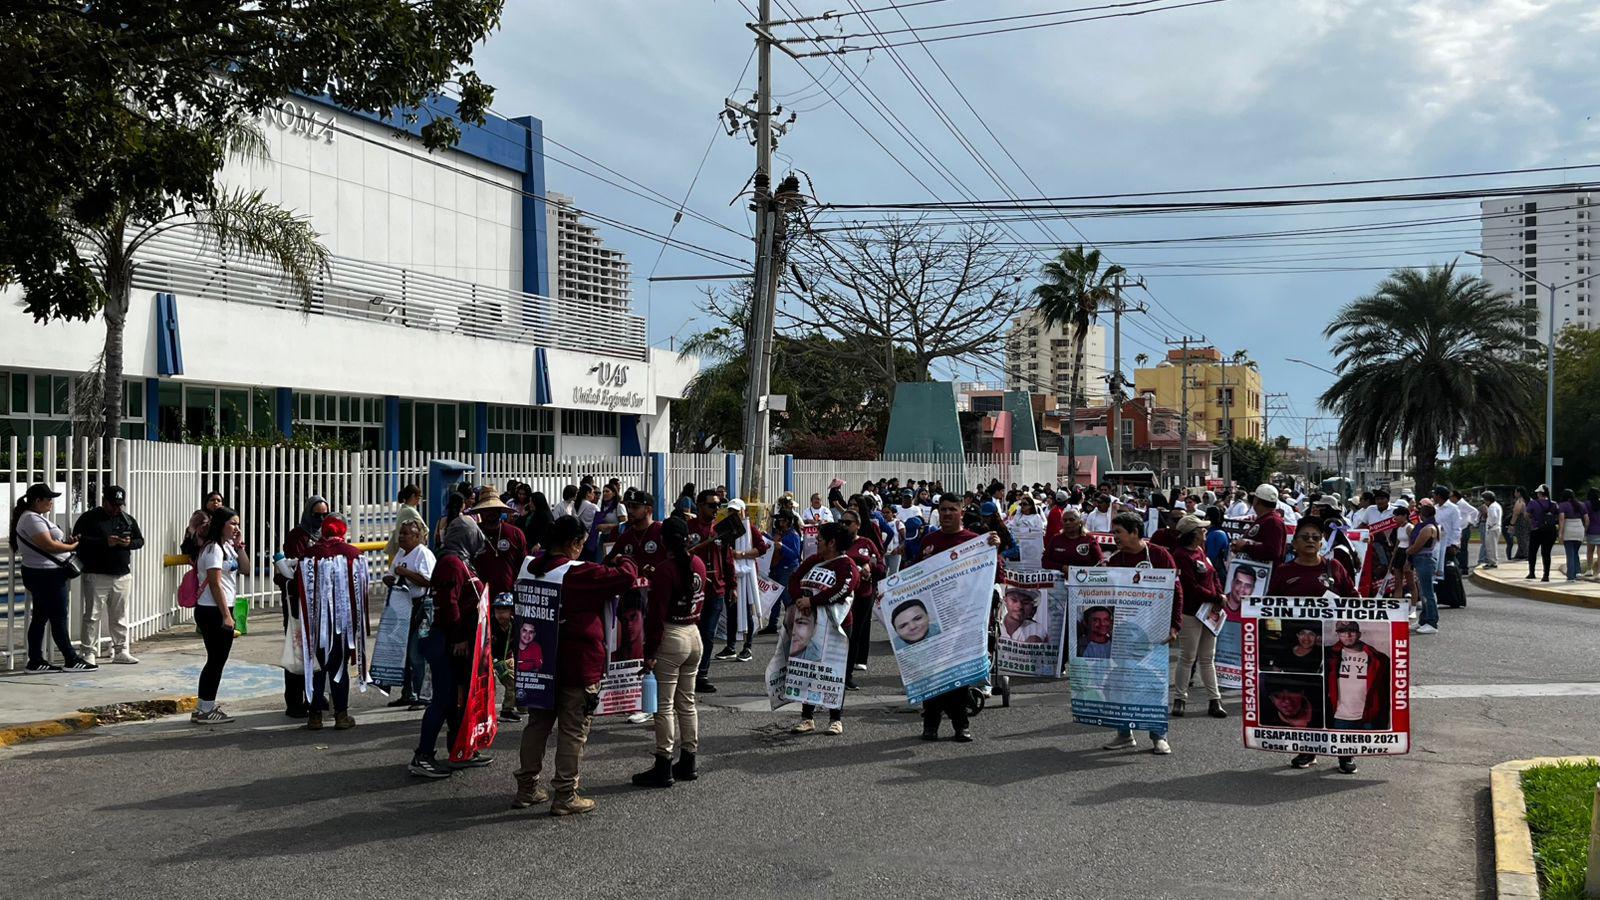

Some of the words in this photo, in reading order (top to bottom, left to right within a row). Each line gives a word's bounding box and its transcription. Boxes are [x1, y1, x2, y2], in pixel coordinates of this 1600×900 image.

[261, 101, 336, 141] NOMA
[1250, 598, 1288, 606] POR
[1294, 598, 1329, 608] LAS
[1334, 598, 1400, 610] VOCES
[1261, 607, 1294, 618] SIN
[1298, 608, 1388, 620] JUSTICIA
[1244, 622, 1256, 721] DESAPARECIDO
[1395, 640, 1407, 710] URGENTE
[820, 674, 843, 684] SINALOA
[1254, 729, 1328, 743] DESAPARECIDO
[1331, 734, 1338, 743] 8
[1340, 734, 1371, 744] ENERO
[1374, 734, 1399, 744] 2021
[1292, 743, 1327, 754] Octavio
